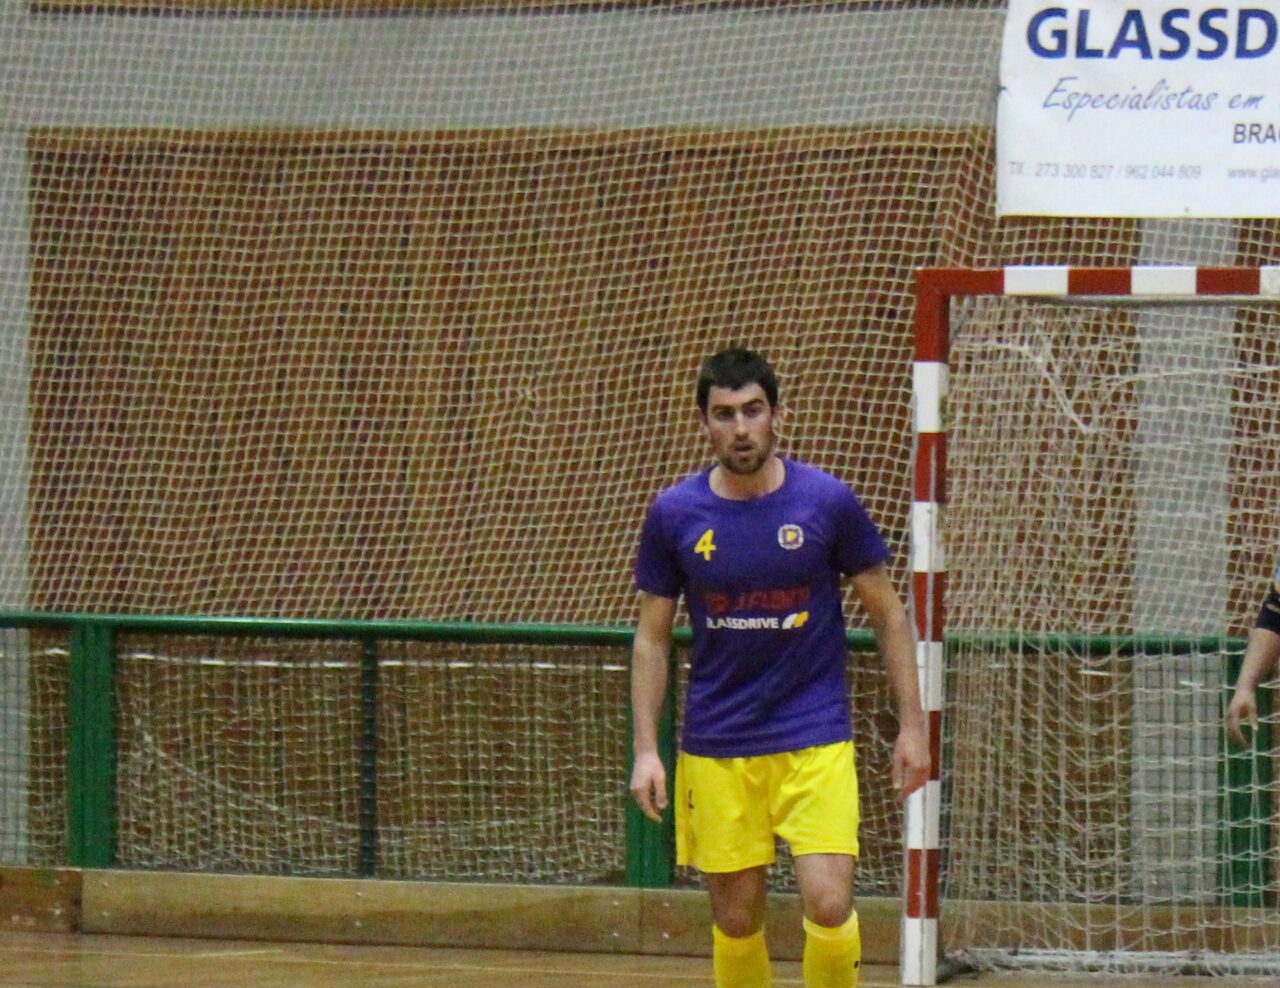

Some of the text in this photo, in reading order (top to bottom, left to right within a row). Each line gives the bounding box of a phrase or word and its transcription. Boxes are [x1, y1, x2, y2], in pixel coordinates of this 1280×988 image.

[1042, 76, 1217, 122] Especialistas
[1228, 93, 1266, 111] em
[1035, 162, 1060, 177] 273
[1063, 163, 1087, 178] 300
[693, 529, 717, 561] 4
